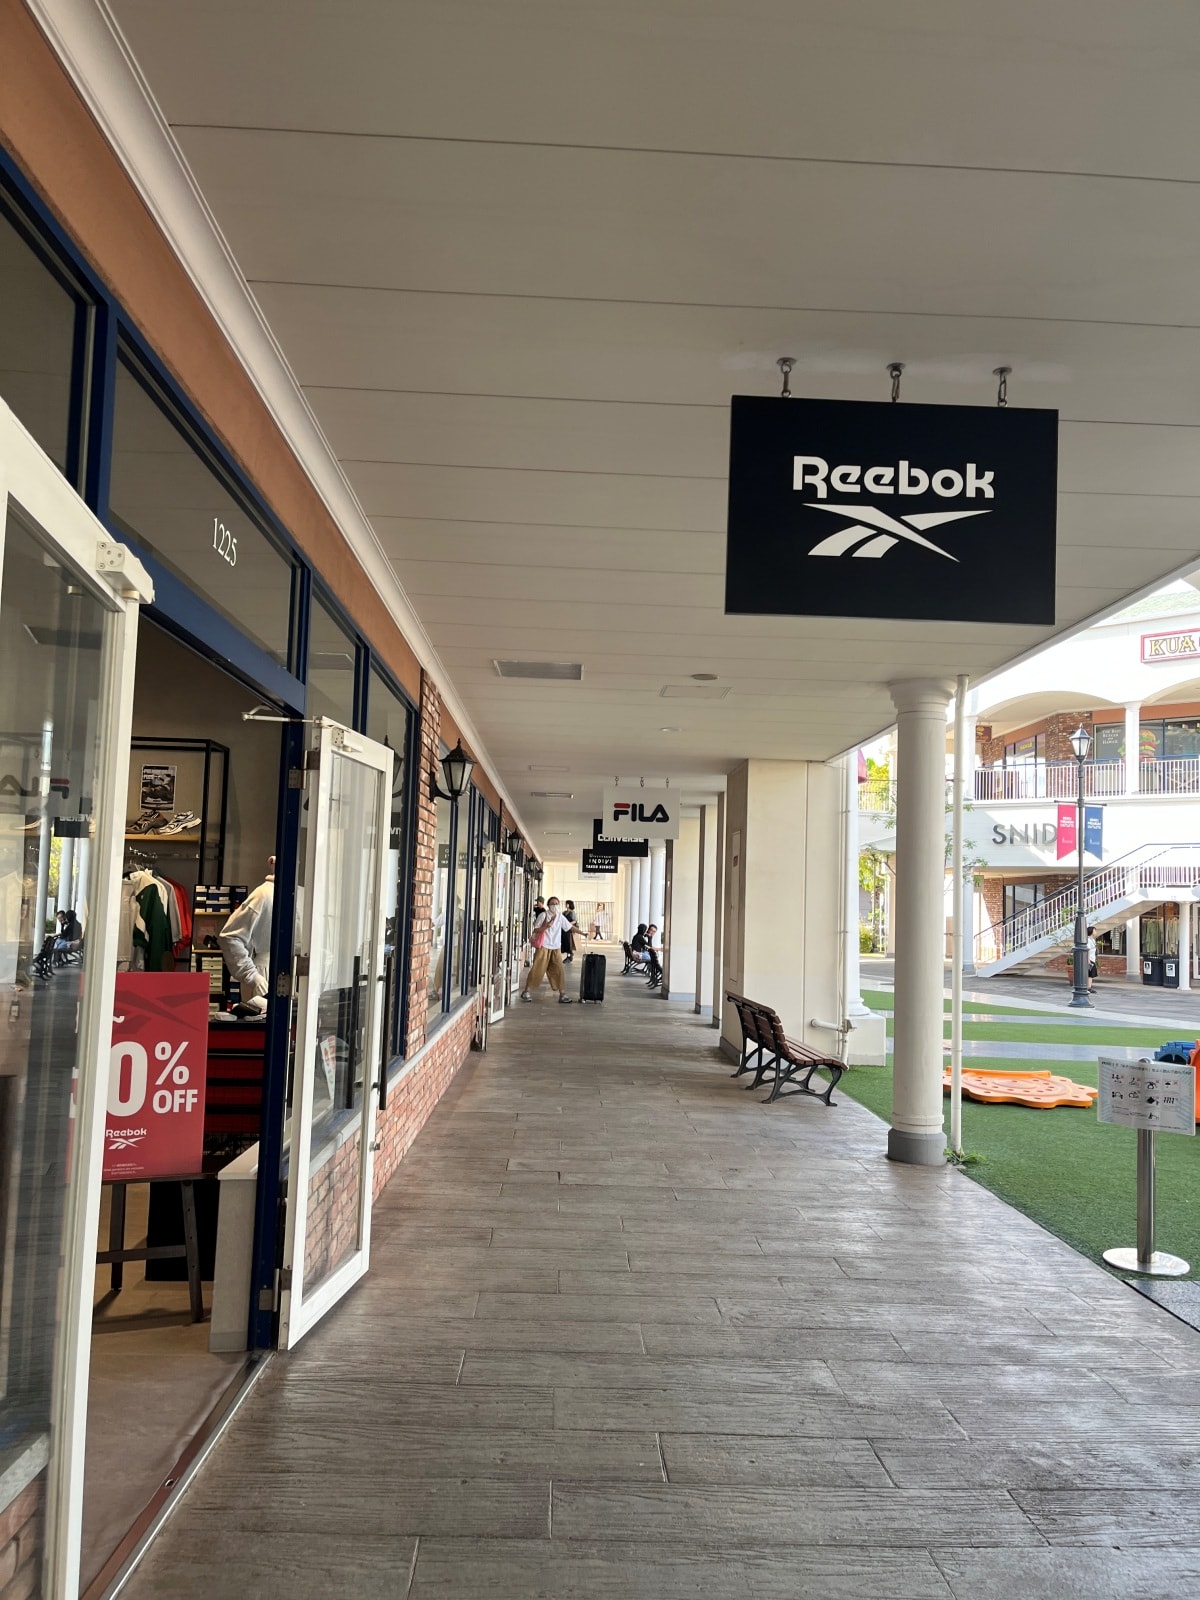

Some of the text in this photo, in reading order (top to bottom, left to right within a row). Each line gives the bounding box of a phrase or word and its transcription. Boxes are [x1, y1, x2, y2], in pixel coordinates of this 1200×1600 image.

[792, 455, 995, 499] Reebok
[212, 517, 238, 567] 1225
[613, 802, 670, 822] FILA
[152, 1089, 198, 1114] OFF
[105, 1127, 147, 1138] Reebok
